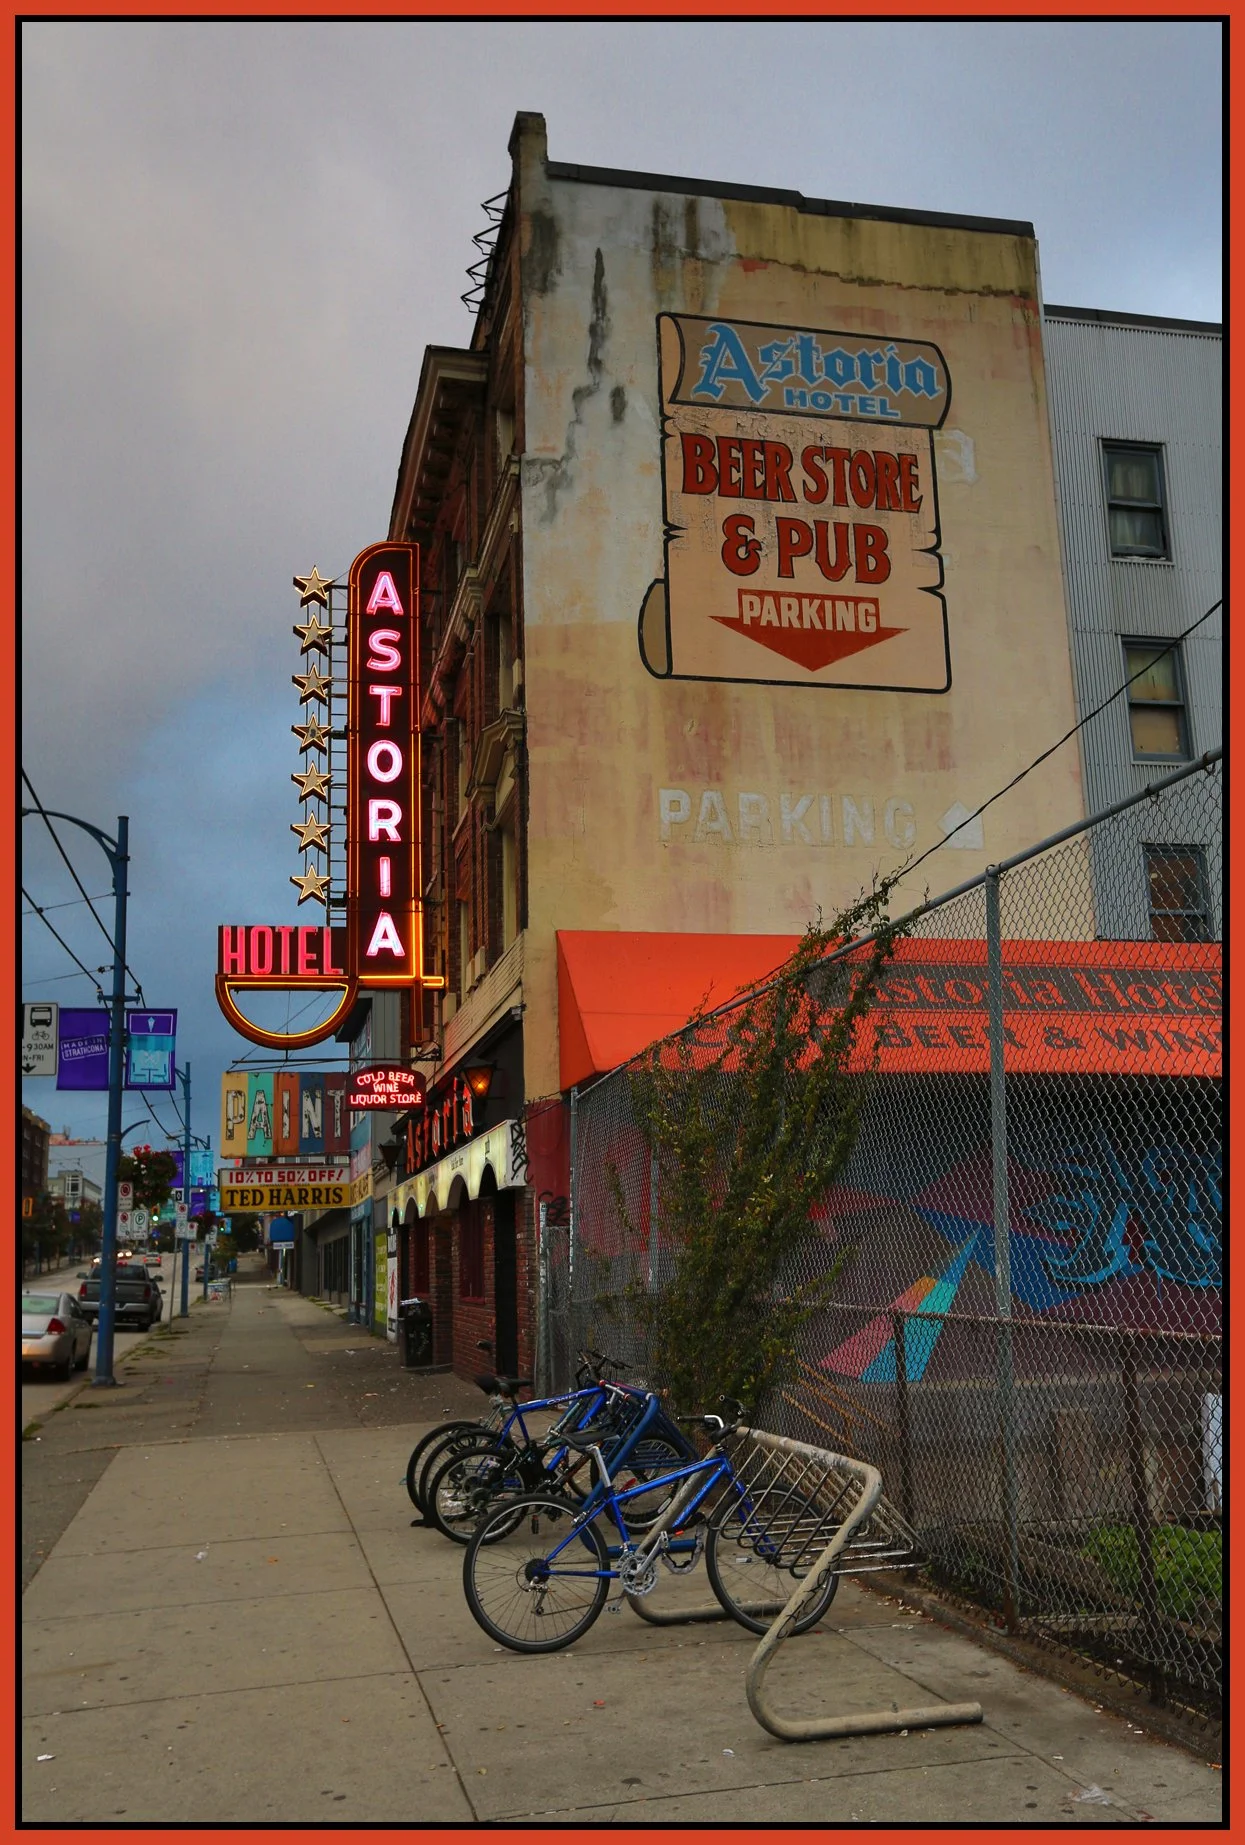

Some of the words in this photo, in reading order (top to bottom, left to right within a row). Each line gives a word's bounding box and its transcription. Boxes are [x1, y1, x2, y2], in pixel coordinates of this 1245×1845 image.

[690, 323, 944, 403] Astoria
[784, 388, 901, 418] HOTEL
[680, 432, 798, 503] BEER
[801, 444, 923, 514] STORE
[721, 513, 762, 577] &
[775, 516, 891, 584] PUB
[742, 595, 878, 634] PARKING
[366, 570, 405, 957] ASTORIA
[658, 787, 917, 850] PARKING
[222, 925, 344, 976] HOTEL
[1073, 972, 1222, 1010] Hote
[64, 1045, 105, 1058] STRATHCONA
[1043, 1026, 1086, 1050] &
[356, 1071, 386, 1086] COLD
[388, 1071, 415, 1087] BEER
[372, 1082, 400, 1093] WINE
[226, 1089, 346, 1141] PAINT
[350, 1094, 387, 1106] LIQUOR
[389, 1091, 422, 1104] STORE
[229, 1171, 254, 1184] 10%
[256, 1170, 273, 1183] TO
[277, 1170, 305, 1183] 50%
[308, 1169, 344, 1182] OFF!
[225, 1189, 264, 1207] TED
[268, 1187, 343, 1205] HARRIS
